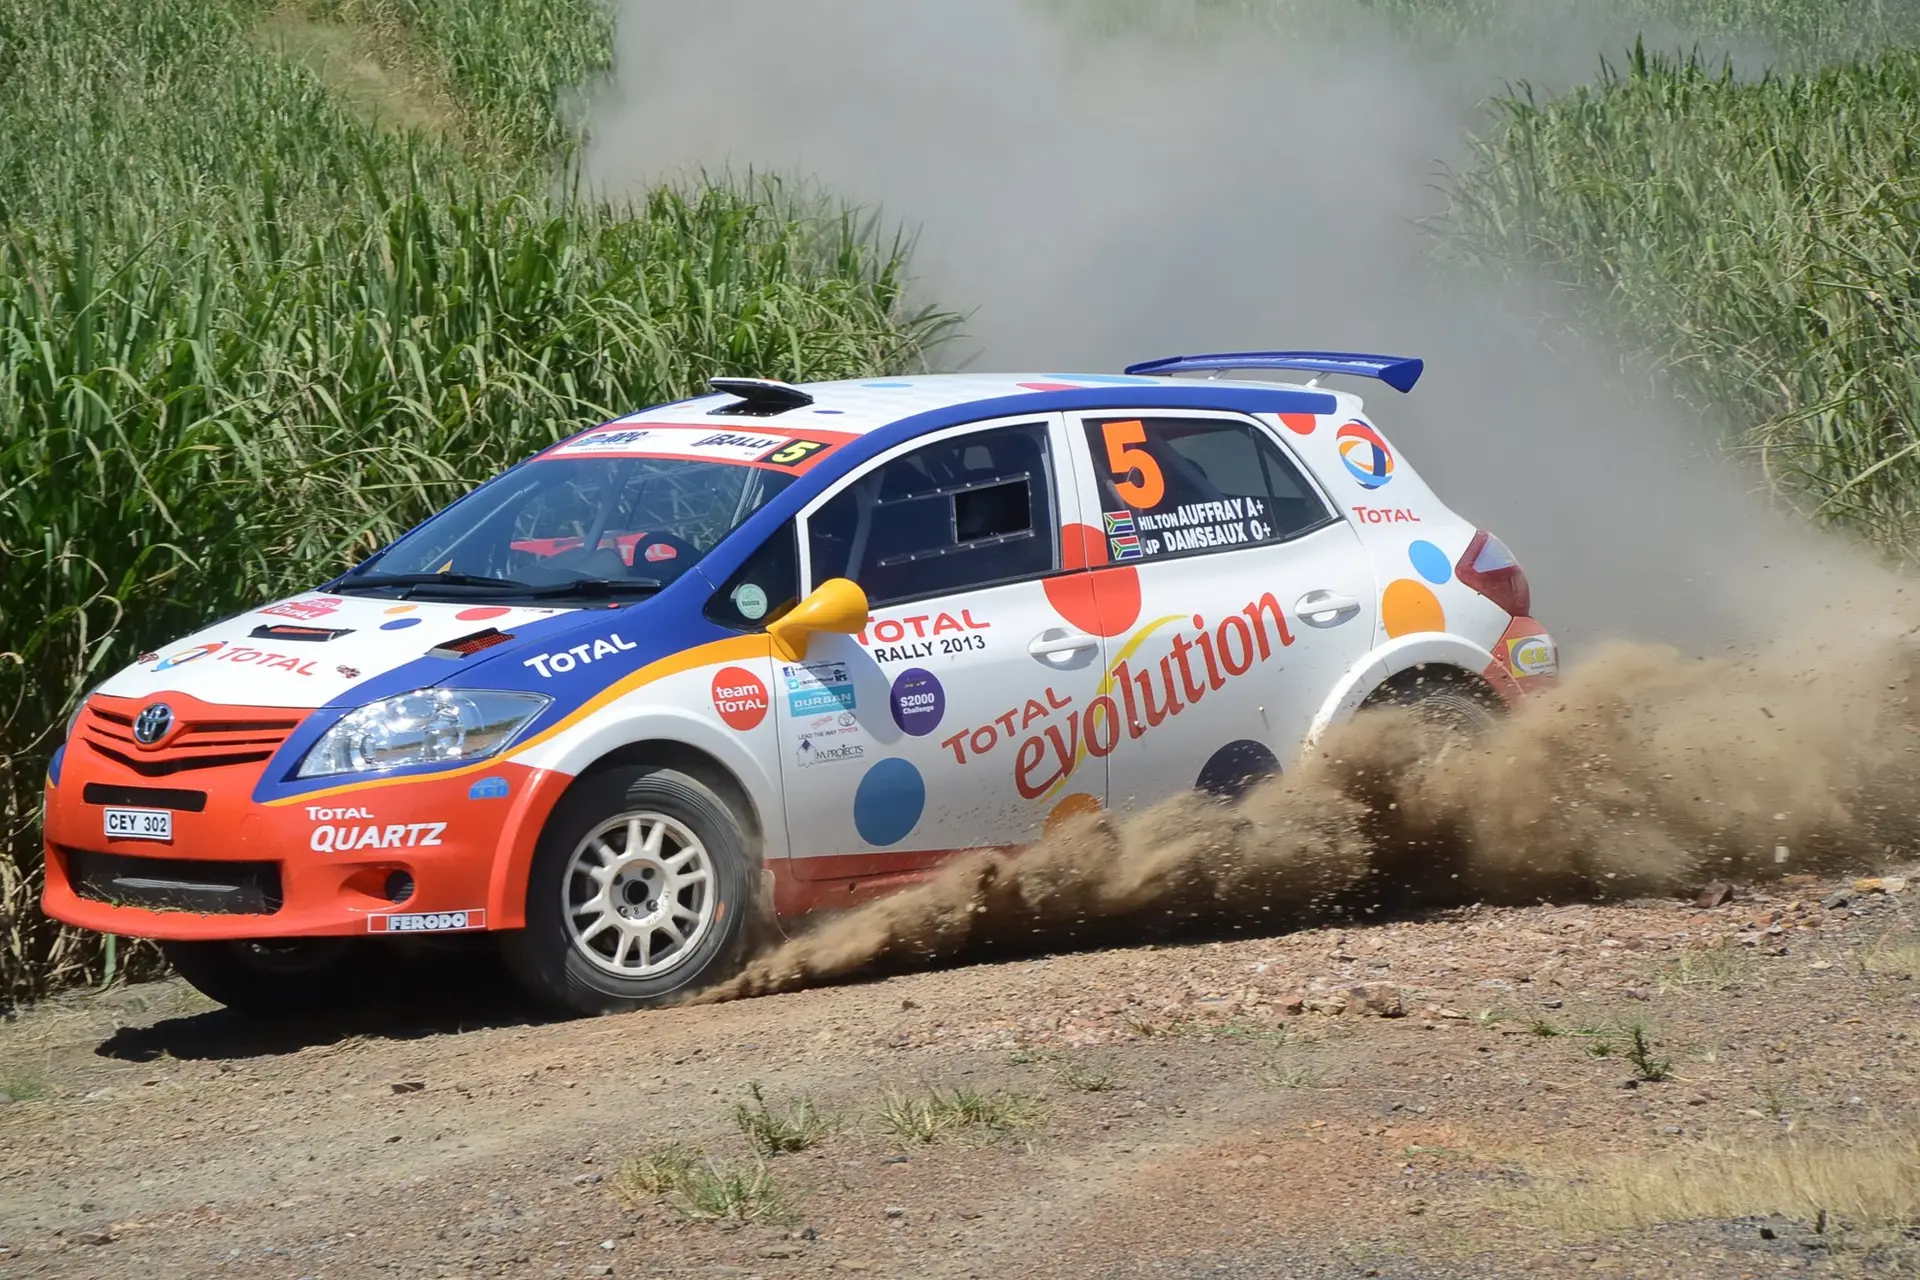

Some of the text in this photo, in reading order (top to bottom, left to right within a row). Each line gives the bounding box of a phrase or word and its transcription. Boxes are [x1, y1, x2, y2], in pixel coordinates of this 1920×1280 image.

[771, 441, 805, 463] 5
[1102, 420, 1164, 509] 5
[1138, 497, 1264, 531] HILTON AUFFRAY A+
[1352, 506, 1421, 524] TOTAL
[1145, 538, 1160, 555] JP
[1163, 523, 1248, 552] DAMSEAUX
[523, 633, 638, 678] TOTAL
[874, 635, 986, 663] RALLY 2013
[217, 647, 318, 676] TOTAL
[716, 684, 760, 699] team
[794, 693, 851, 708] DURBAN
[900, 693, 935, 707] S2000
[1015, 592, 1296, 800] evolution
[715, 698, 767, 713] TOTAL
[903, 705, 935, 714] Challenge
[798, 732, 812, 740] LEAD
[942, 687, 1073, 765] TOTAL
[109, 813, 167, 832] CEY 302
[305, 806, 375, 821] TOTAL
[310, 822, 448, 853] QUARTZ
[389, 914, 467, 930] FERODO
